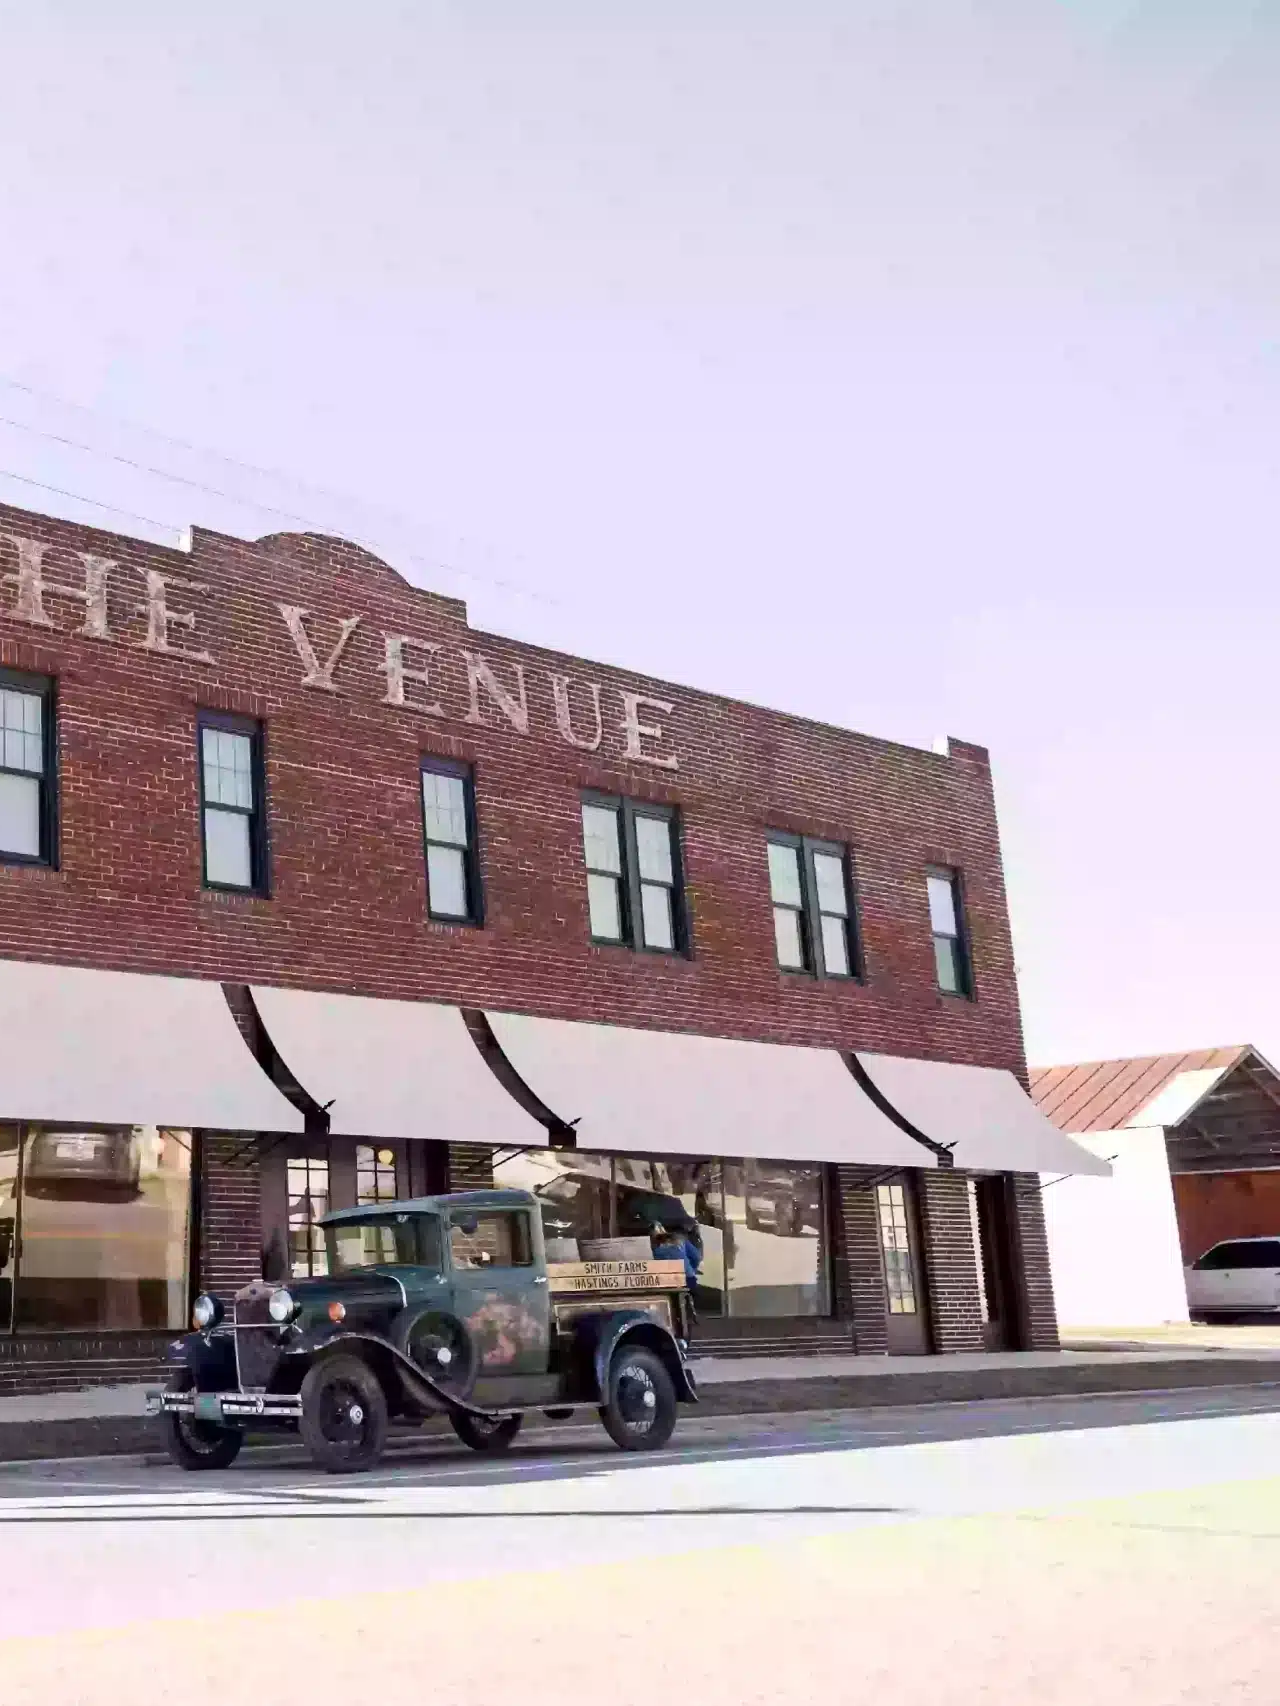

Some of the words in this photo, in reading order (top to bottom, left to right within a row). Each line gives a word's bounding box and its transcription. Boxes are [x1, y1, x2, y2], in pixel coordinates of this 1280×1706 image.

[276, 602, 680, 770] VENUE
[584, 1263, 612, 1274] SMITH
[618, 1262, 648, 1273] FARMS
[575, 1277, 619, 1290] HASTINGS
[624, 1274, 661, 1288] FLORIDA
